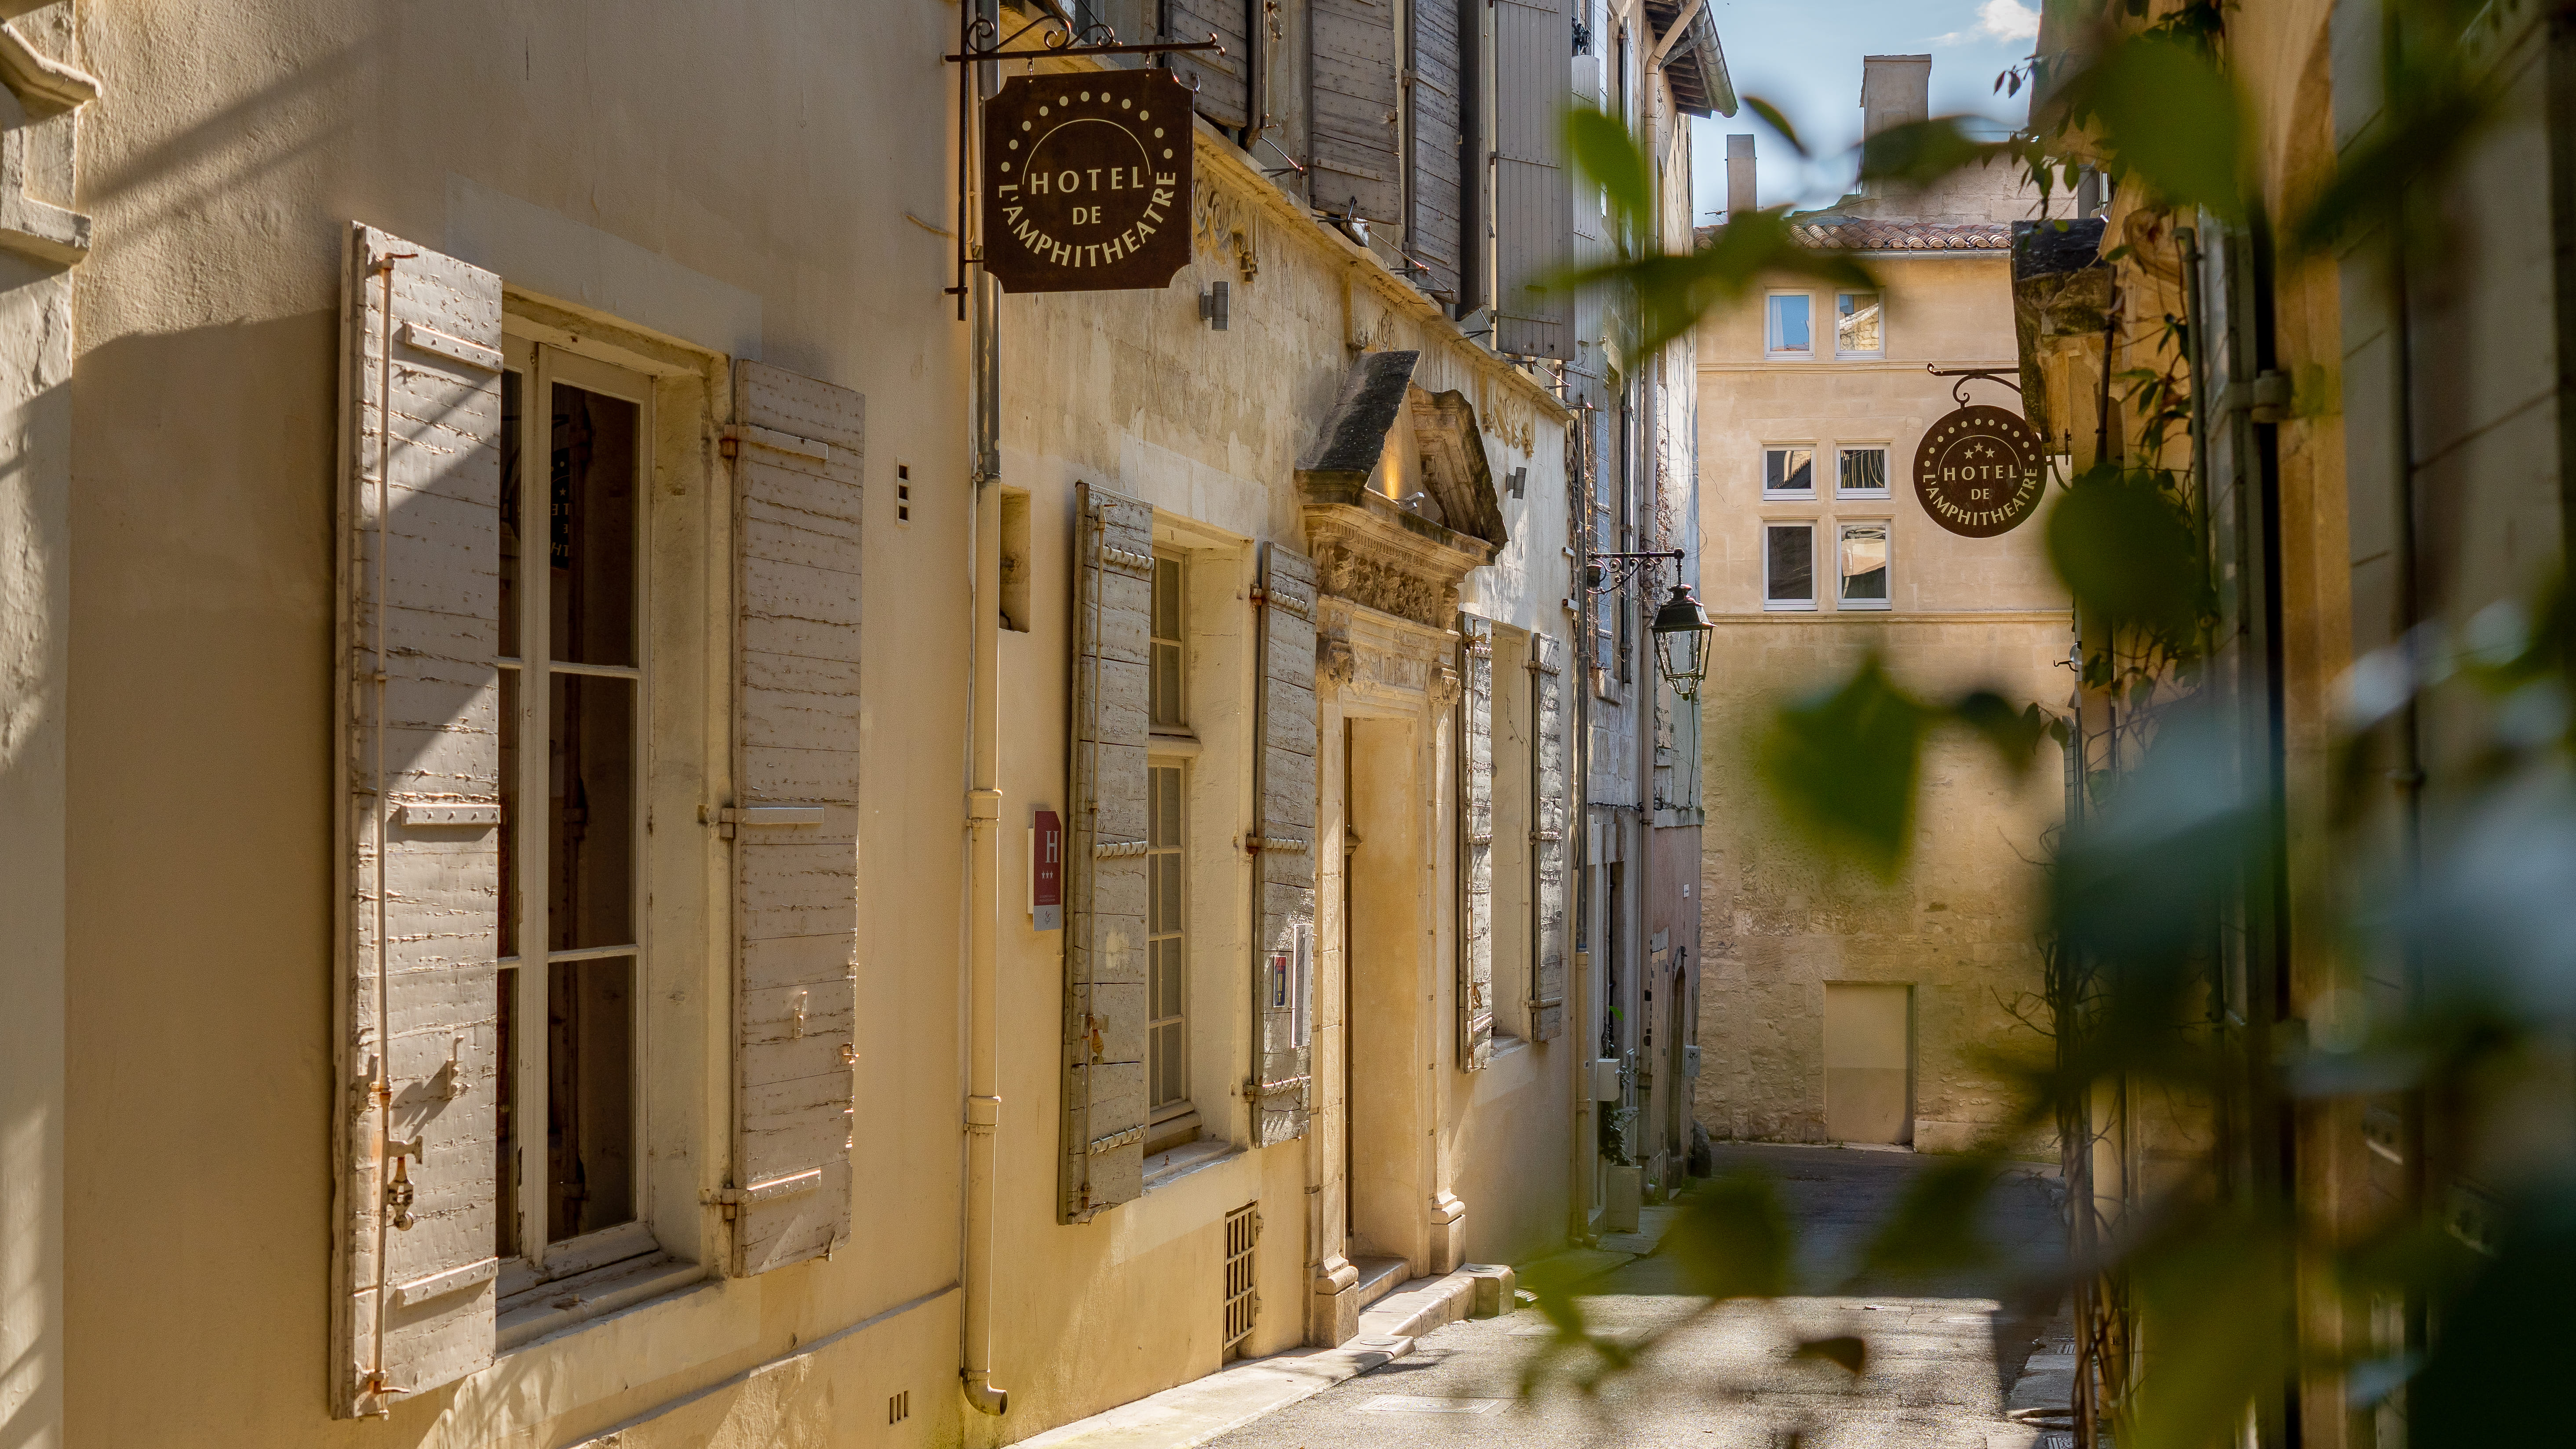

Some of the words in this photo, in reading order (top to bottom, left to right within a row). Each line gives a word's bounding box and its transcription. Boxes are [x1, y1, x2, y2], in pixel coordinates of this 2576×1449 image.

[1031, 166, 1144, 195] HOTEL
[998, 172, 1176, 267] L'AMPHITHEATRE
[1073, 206, 1100, 225] DE
[1944, 465, 2017, 481] HOTEL
[1923, 468, 2037, 526] L'AMPHITHEATRE
[1971, 488, 1989, 500] DE
[1045, 830, 1059, 863] H
